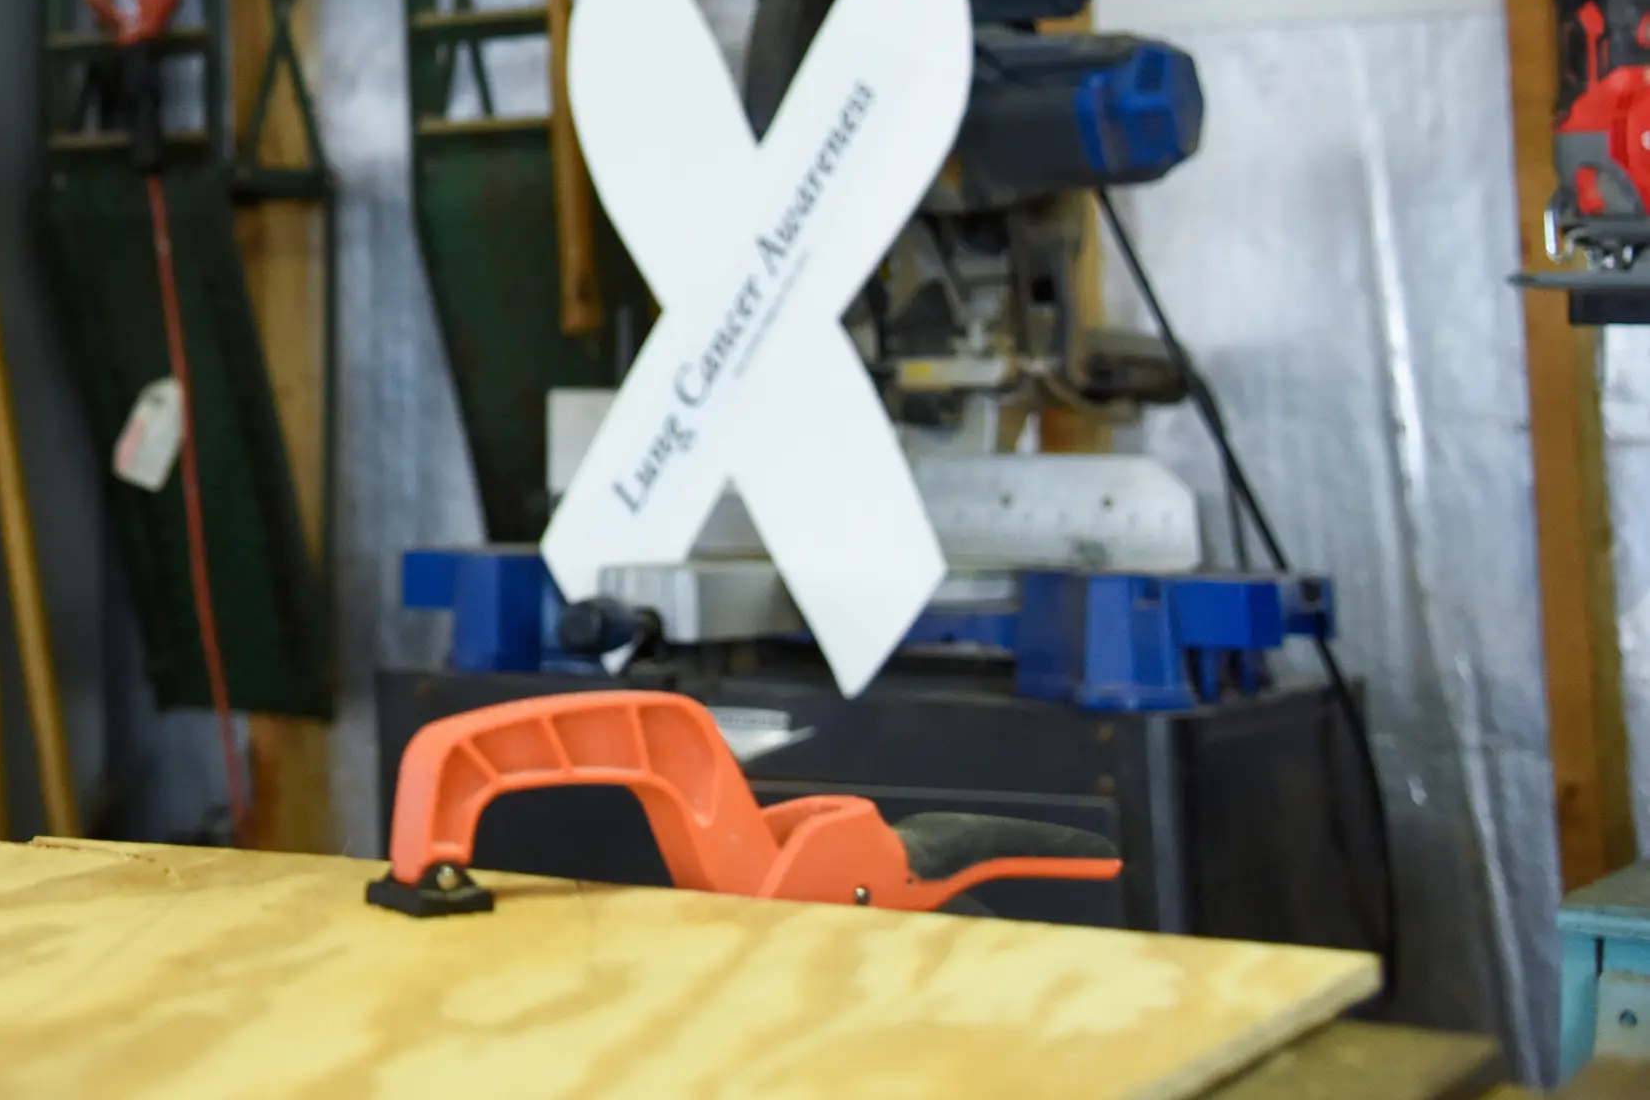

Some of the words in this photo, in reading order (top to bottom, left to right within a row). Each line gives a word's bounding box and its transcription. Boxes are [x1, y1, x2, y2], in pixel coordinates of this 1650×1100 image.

[611, 411, 698, 516] Lung
[673, 272, 763, 408] Cancer
[754, 79, 876, 277] Awareness
